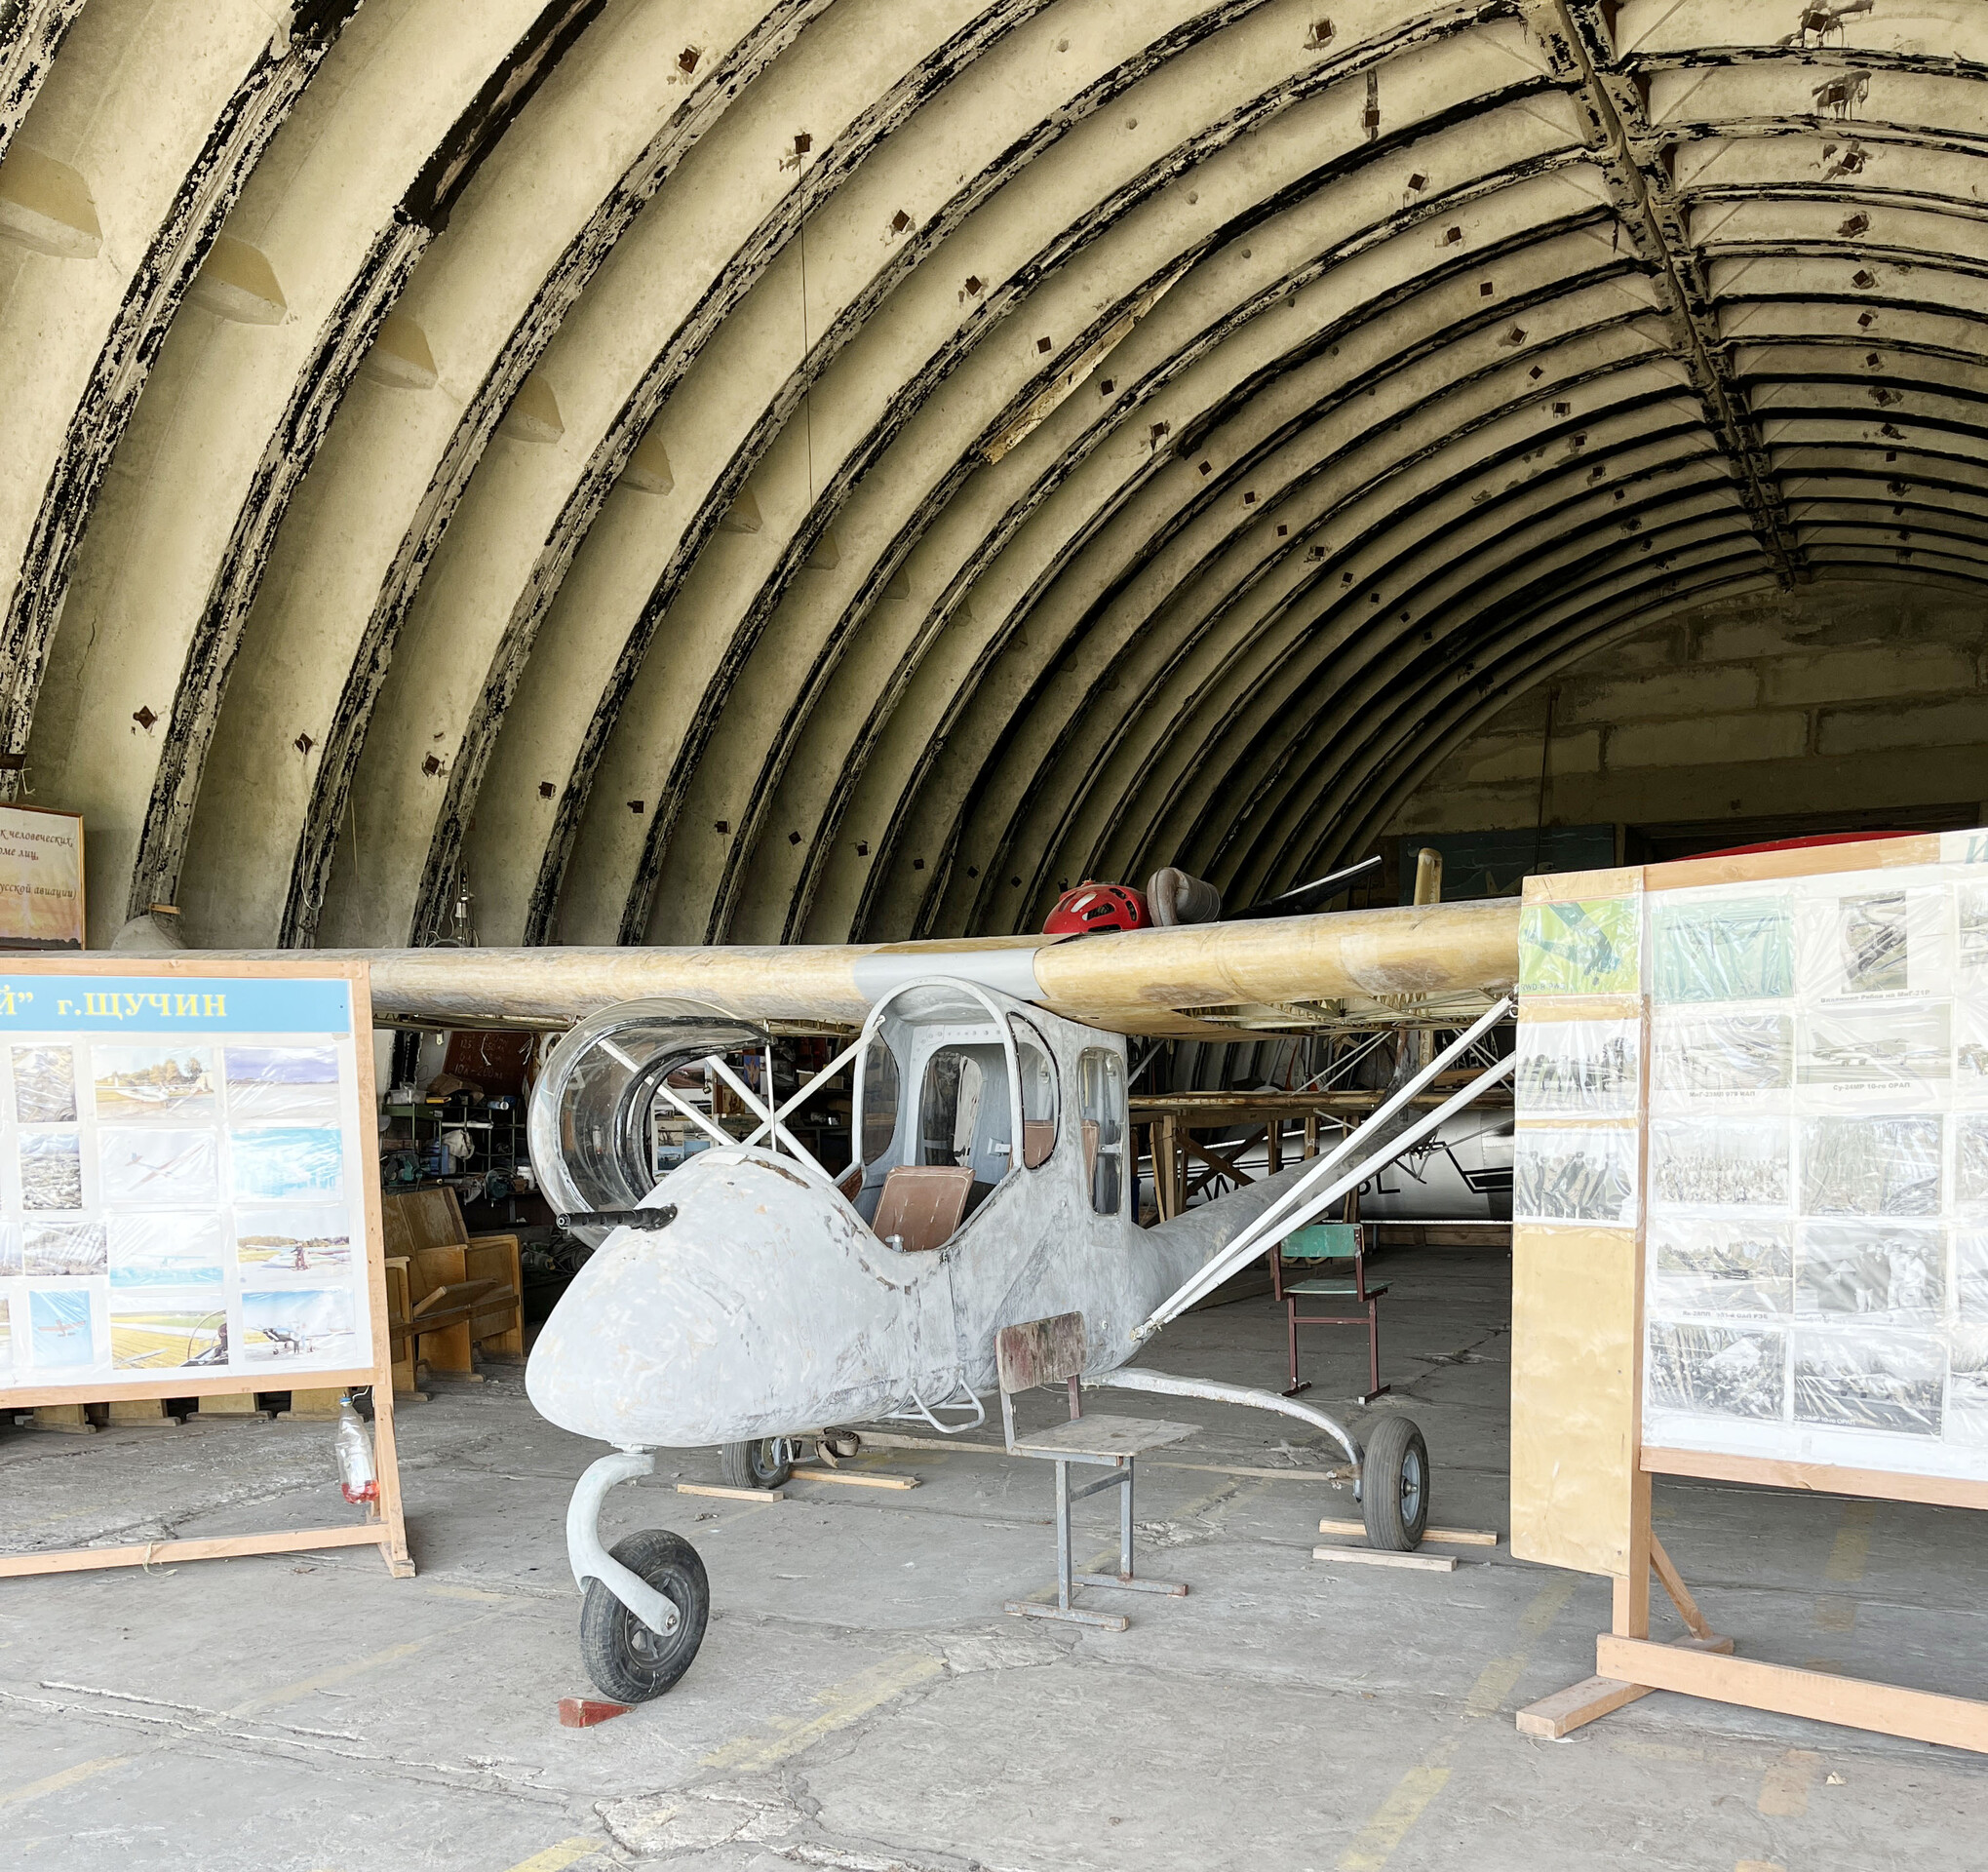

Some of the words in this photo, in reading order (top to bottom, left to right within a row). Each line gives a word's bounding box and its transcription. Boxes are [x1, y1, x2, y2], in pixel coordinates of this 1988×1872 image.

[9, 831, 73, 847] человеческих,
[18, 851, 39, 860] лиц,
[34, 887, 77, 899] авиации)
[57, 993, 227, 1021] г.ЩУЧИН
